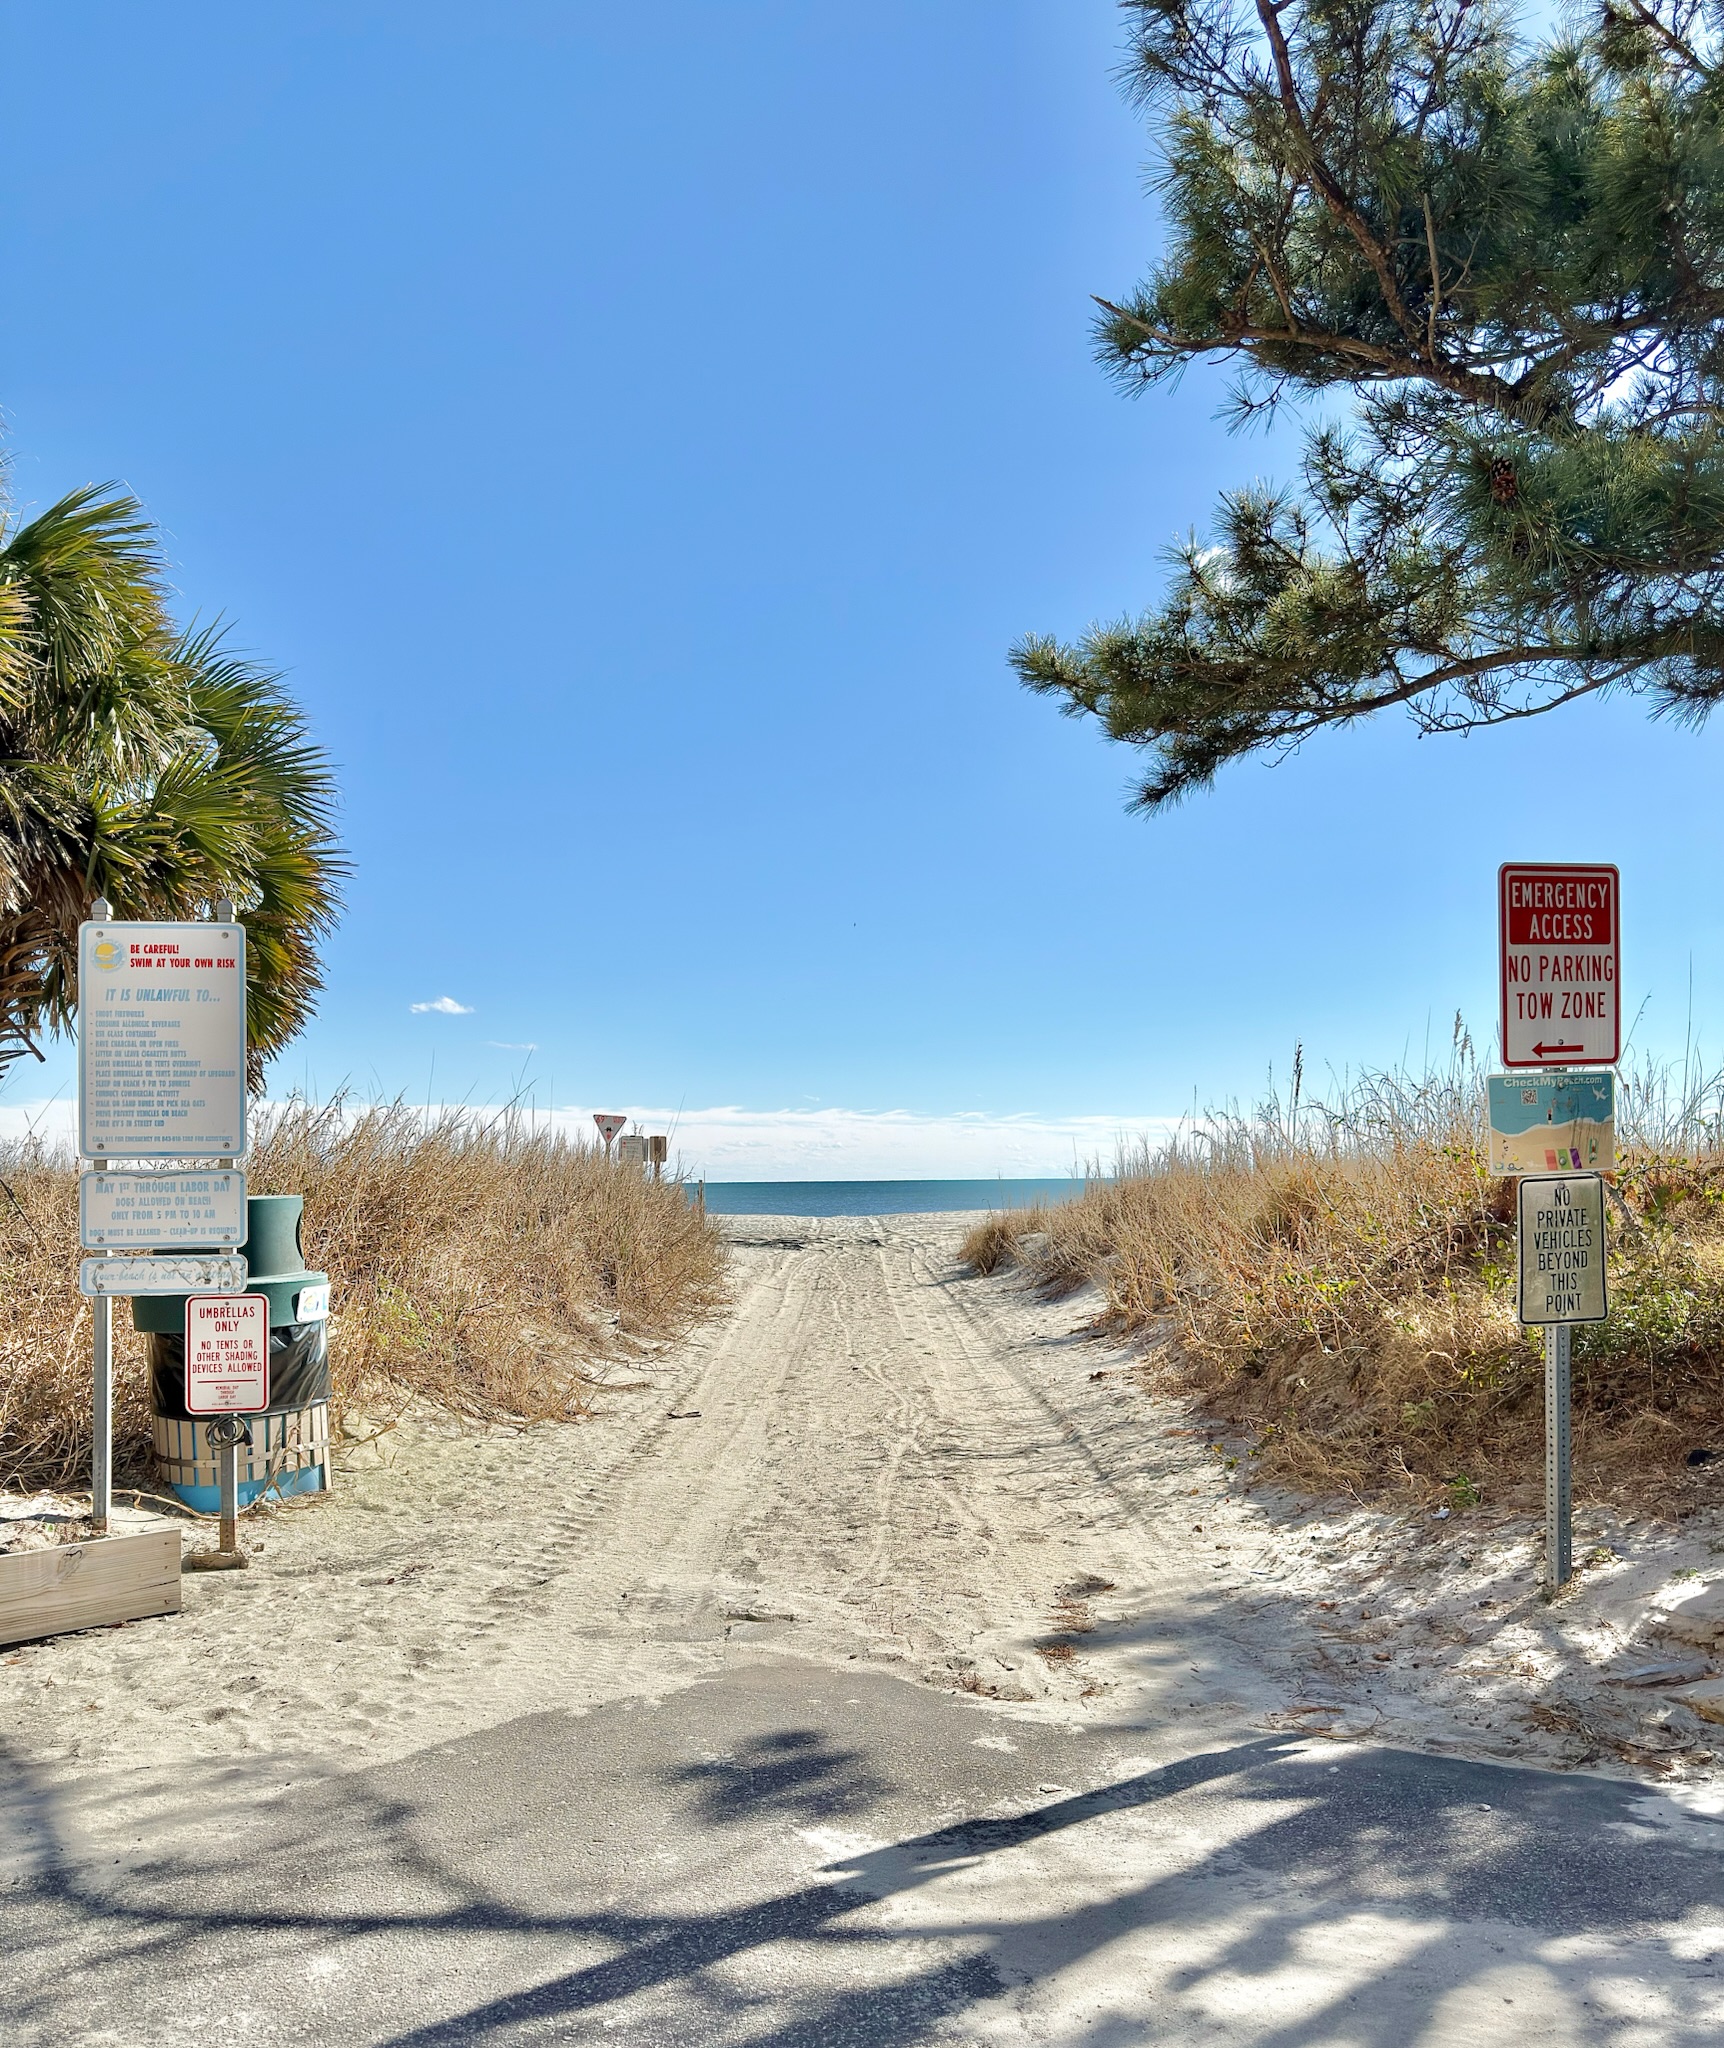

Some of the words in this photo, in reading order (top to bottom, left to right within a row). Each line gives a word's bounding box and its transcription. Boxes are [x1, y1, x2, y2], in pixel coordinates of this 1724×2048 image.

[1512, 882, 1607, 908] EMERGENCY
[1530, 914, 1592, 939] ACCESS
[130, 945, 140, 954] BE
[143, 945, 179, 954] CAREFUL!
[130, 958, 152, 968] SWIM
[156, 958, 166, 968] AT
[169, 958, 190, 968] YOUR
[194, 958, 213, 968] OWN
[216, 958, 235, 968] RISK
[1508, 955, 1530, 982] NO
[1540, 955, 1613, 982] PARKING
[105, 989, 116, 1002] IT
[120, 989, 130, 1002] IS
[136, 989, 190, 1002] UNLAWFUL
[196, 989, 220, 1002] TO...
[1516, 992, 1552, 1019] TOW
[1561, 992, 1606, 1019] ZONE
[95, 1182, 114, 1193] MAY
[119, 1182, 129, 1192] 1ST
[134, 1182, 176, 1193] THROUGH
[181, 1182, 209, 1192] LABOR
[214, 1181, 230, 1192] DAY
[116, 1197, 135, 1206] DOGS
[139, 1197, 171, 1206] ALLOWED
[175, 1197, 185, 1206] ON
[188, 1196, 211, 1205] BEACH
[1555, 1189, 1570, 1206] NO
[111, 1210, 129, 1220] ONLY
[132, 1210, 153, 1219] FROM
[157, 1210, 161, 1219] 5
[165, 1210, 176, 1219] PM
[179, 1210, 189, 1219] TO
[193, 1210, 200, 1219] 10
[204, 1210, 215, 1218] AM
[1537, 1208, 1588, 1228] PRIVATE
[108, 1228, 123, 1236] MUST
[127, 1228, 133, 1236] BE
[137, 1228, 160, 1236] LEASHED
[1534, 1230, 1592, 1250] VEHICLES
[1539, 1251, 1588, 1270] BEYOND
[1551, 1273, 1577, 1291] THIS
[1546, 1293, 1581, 1312] POINT
[199, 1307, 255, 1318] UMBRELLAS
[215, 1321, 239, 1332] ONLY
[201, 1341, 211, 1350] NO
[216, 1340, 238, 1349] TENTS
[243, 1340, 253, 1349] OR
[197, 1352, 220, 1361] OTHER
[225, 1351, 258, 1360] SHADING
[192, 1364, 222, 1373] DEVICES
[227, 1363, 262, 1372] ALLOWED
